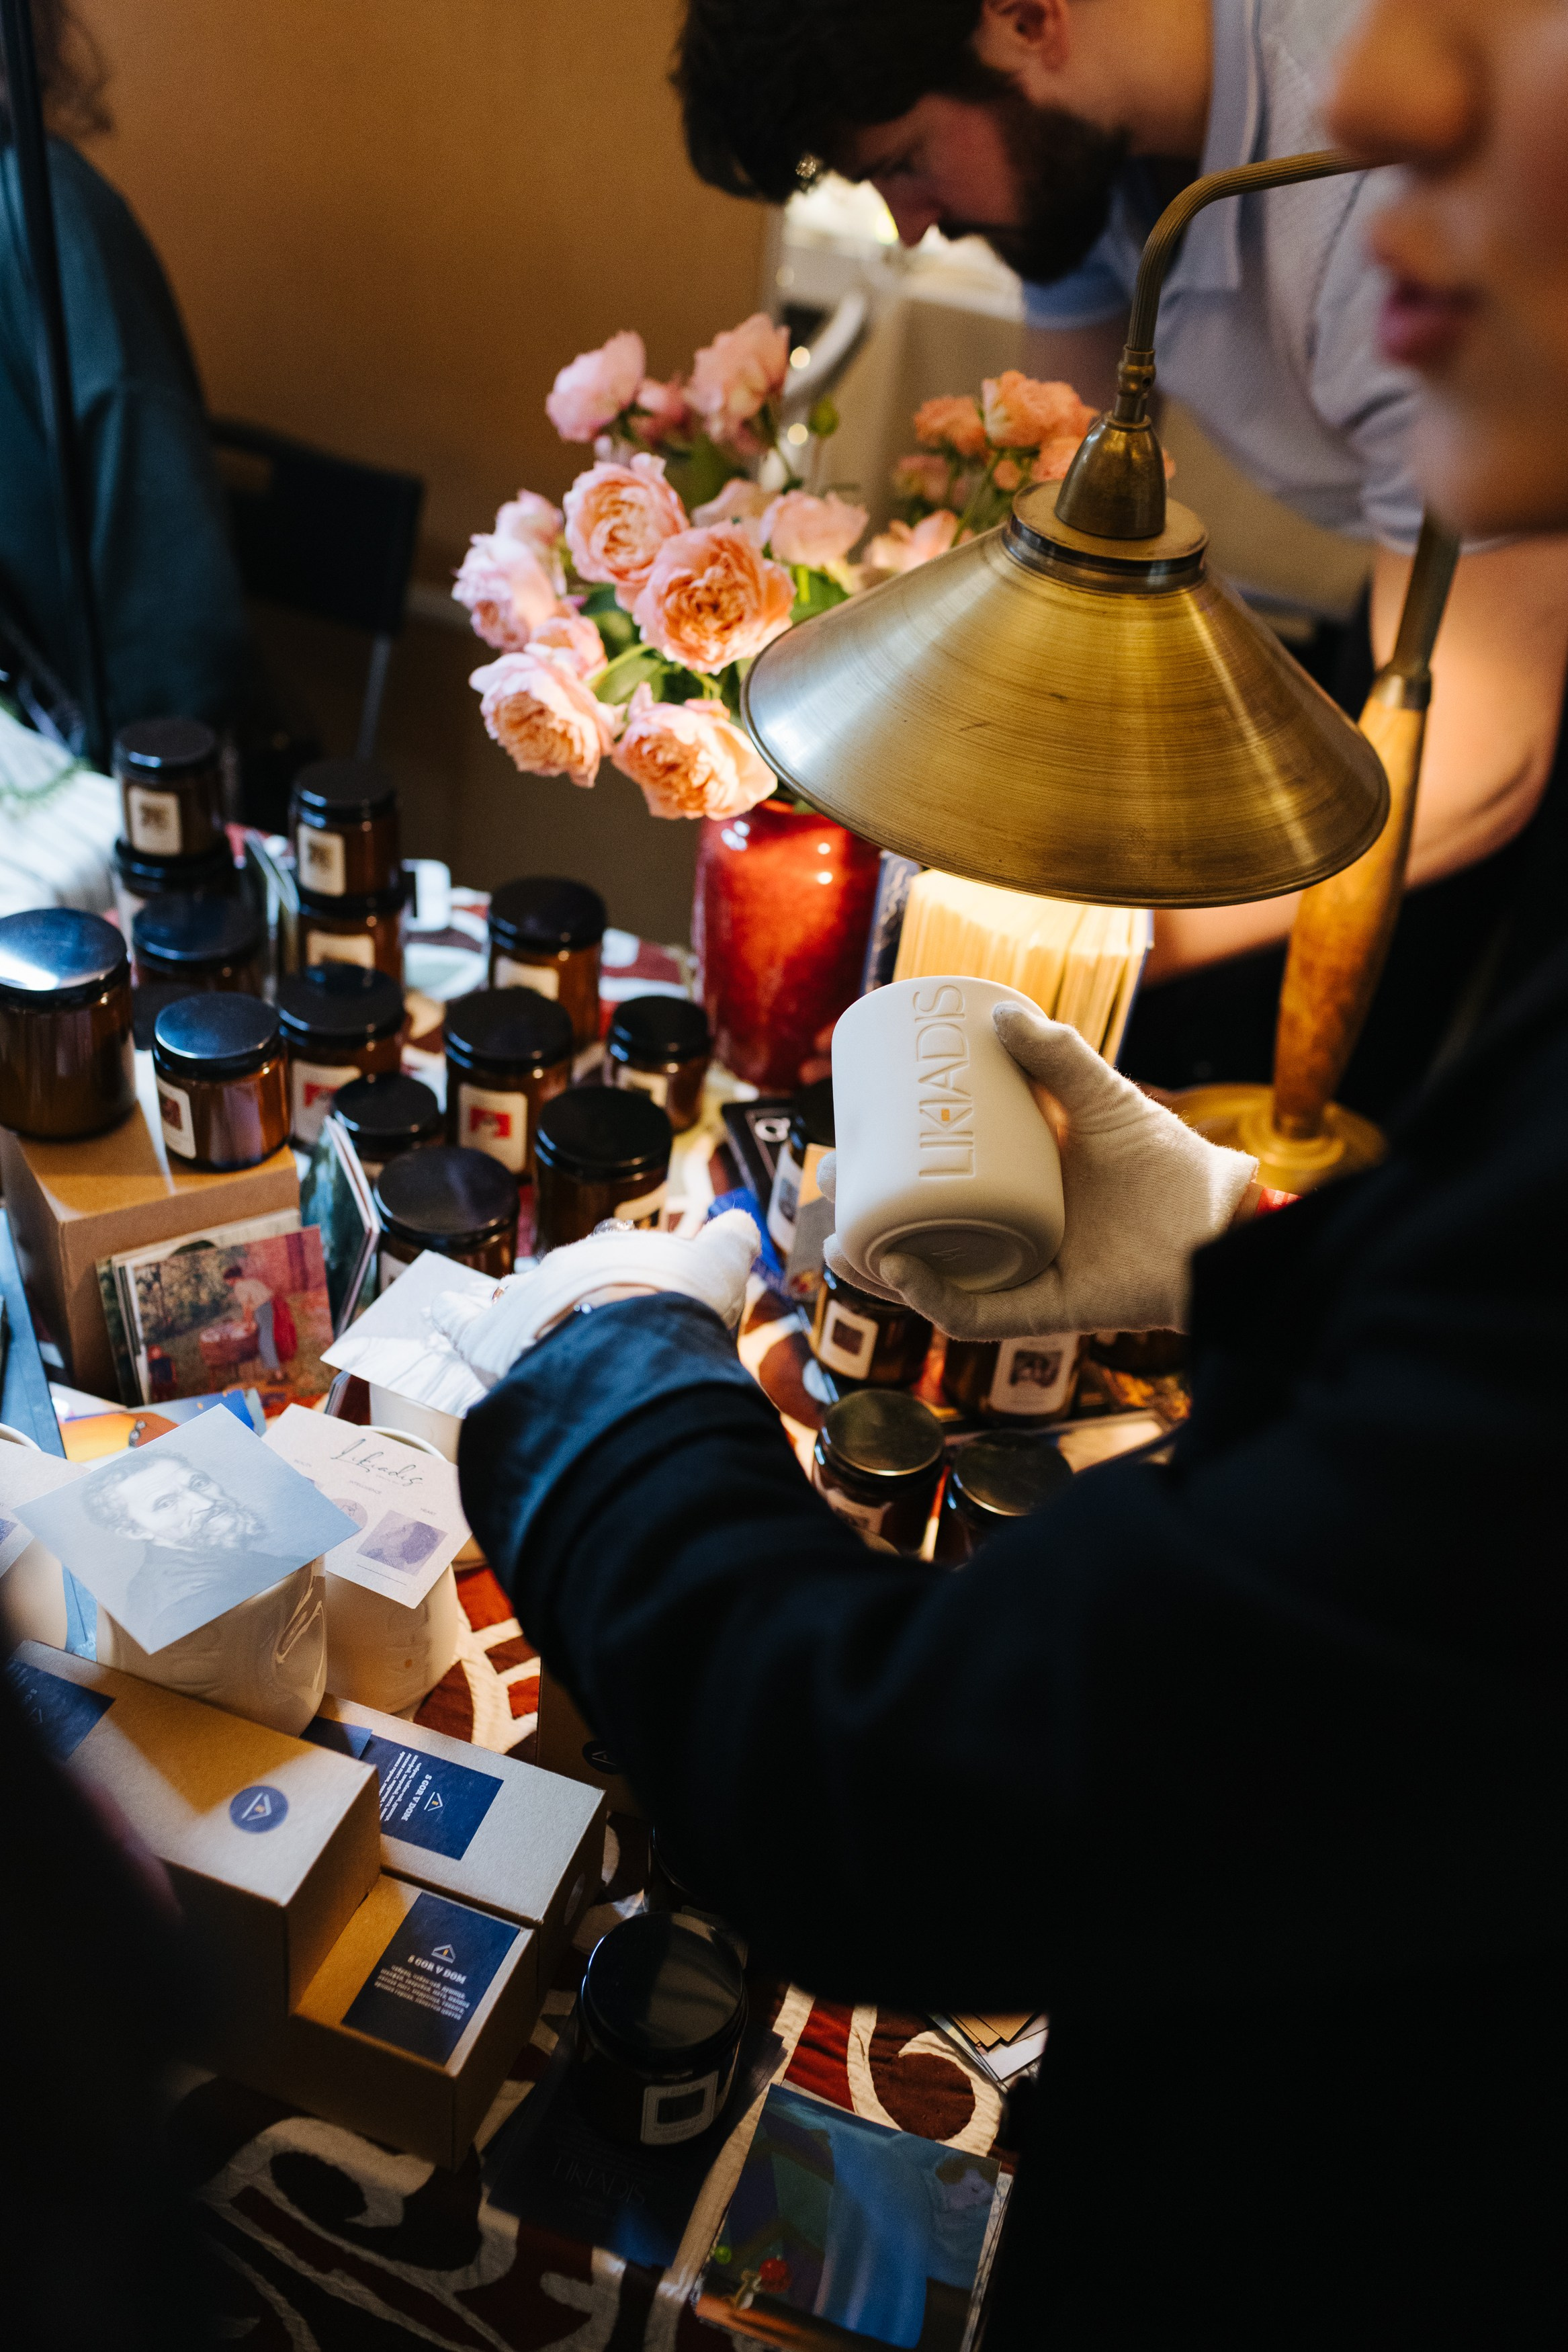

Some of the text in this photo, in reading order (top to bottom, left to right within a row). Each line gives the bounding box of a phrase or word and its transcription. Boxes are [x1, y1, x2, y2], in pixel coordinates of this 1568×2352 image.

[912, 984, 975, 1178] LIKIADIS
[415, 1779, 429, 1796] GOR
[401, 1802, 417, 1822] DOM
[415, 1957, 435, 1972] GOR
[435, 1964, 445, 1974] V
[442, 1968, 468, 1984] DOM
